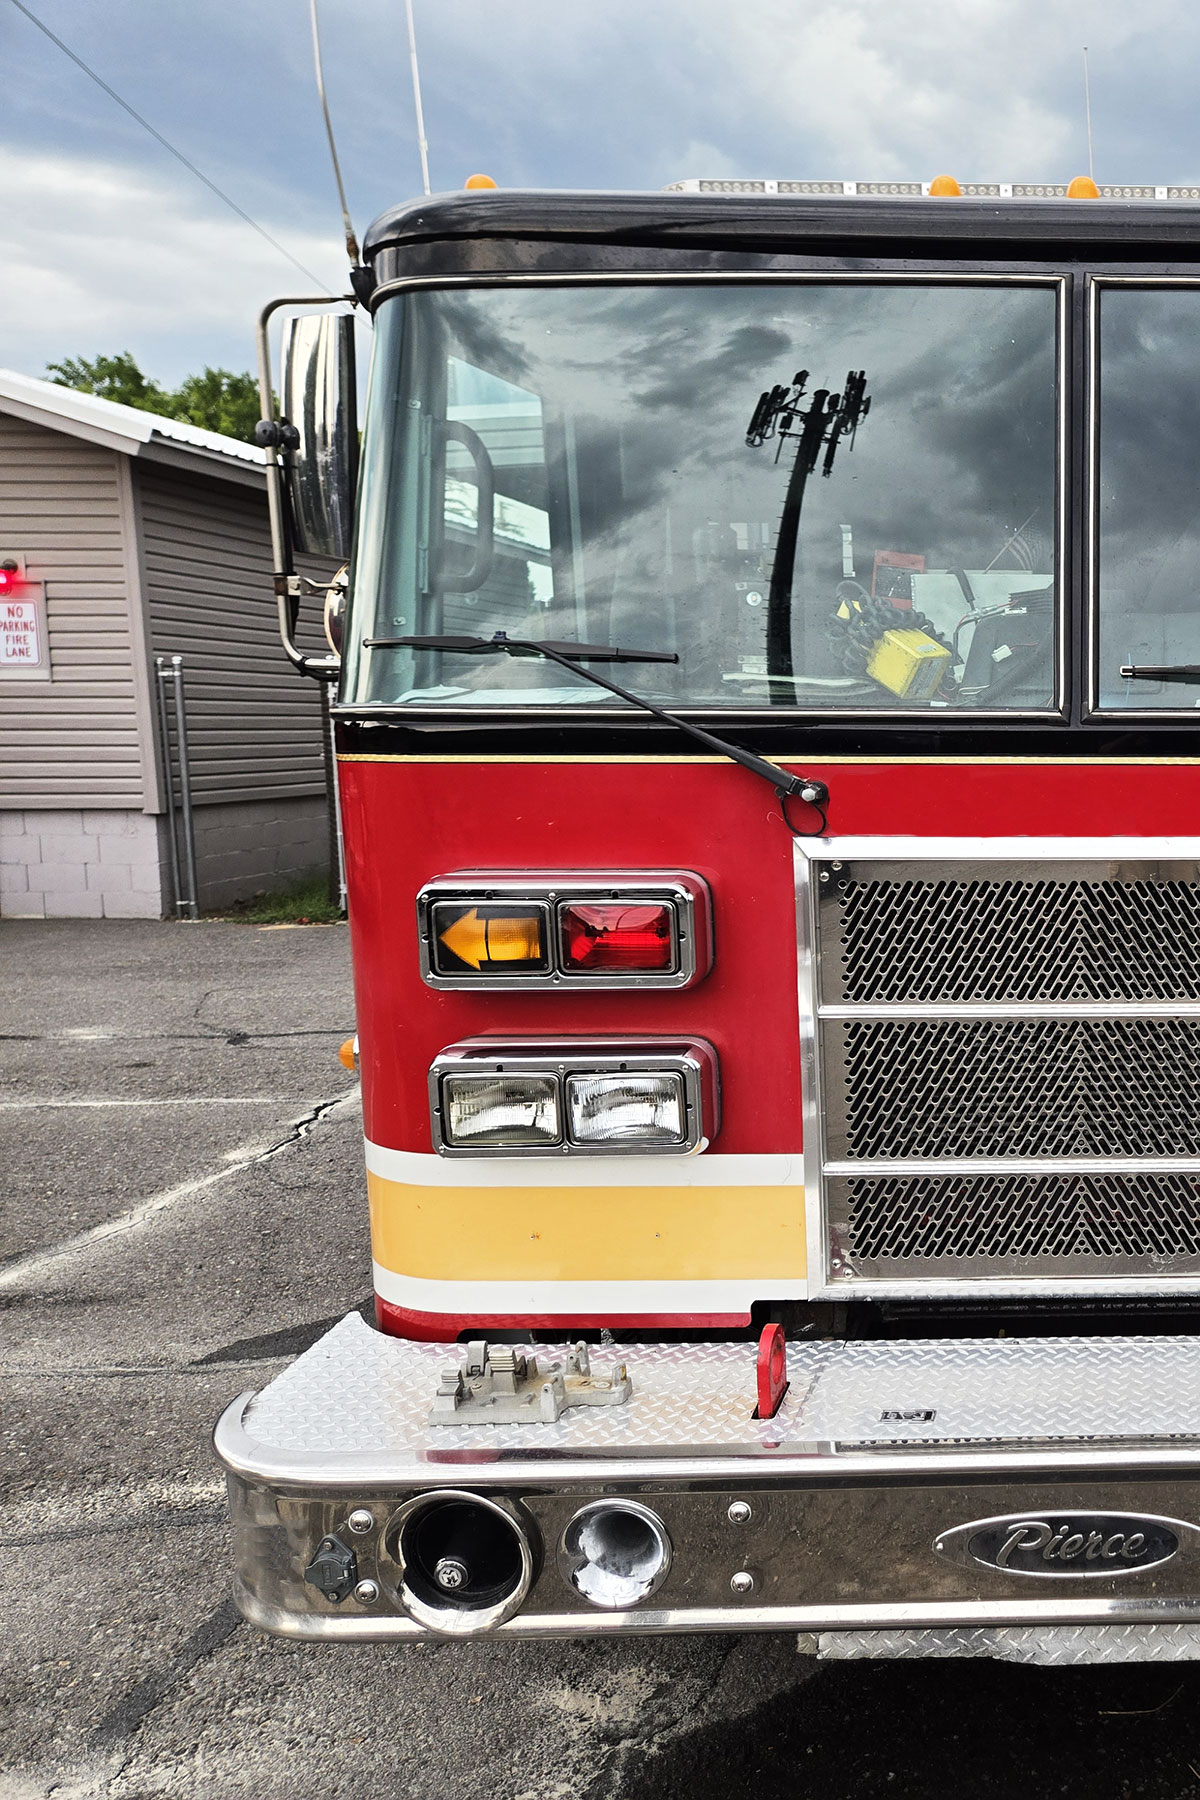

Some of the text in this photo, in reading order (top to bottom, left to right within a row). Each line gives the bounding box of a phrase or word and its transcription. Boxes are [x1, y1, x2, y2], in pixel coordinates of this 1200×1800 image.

[7, 606, 24, 618] NO
[5, 634, 29, 645] FIRE
[5, 647, 32, 657] LANE
[996, 1521, 1148, 1567] Pierce
